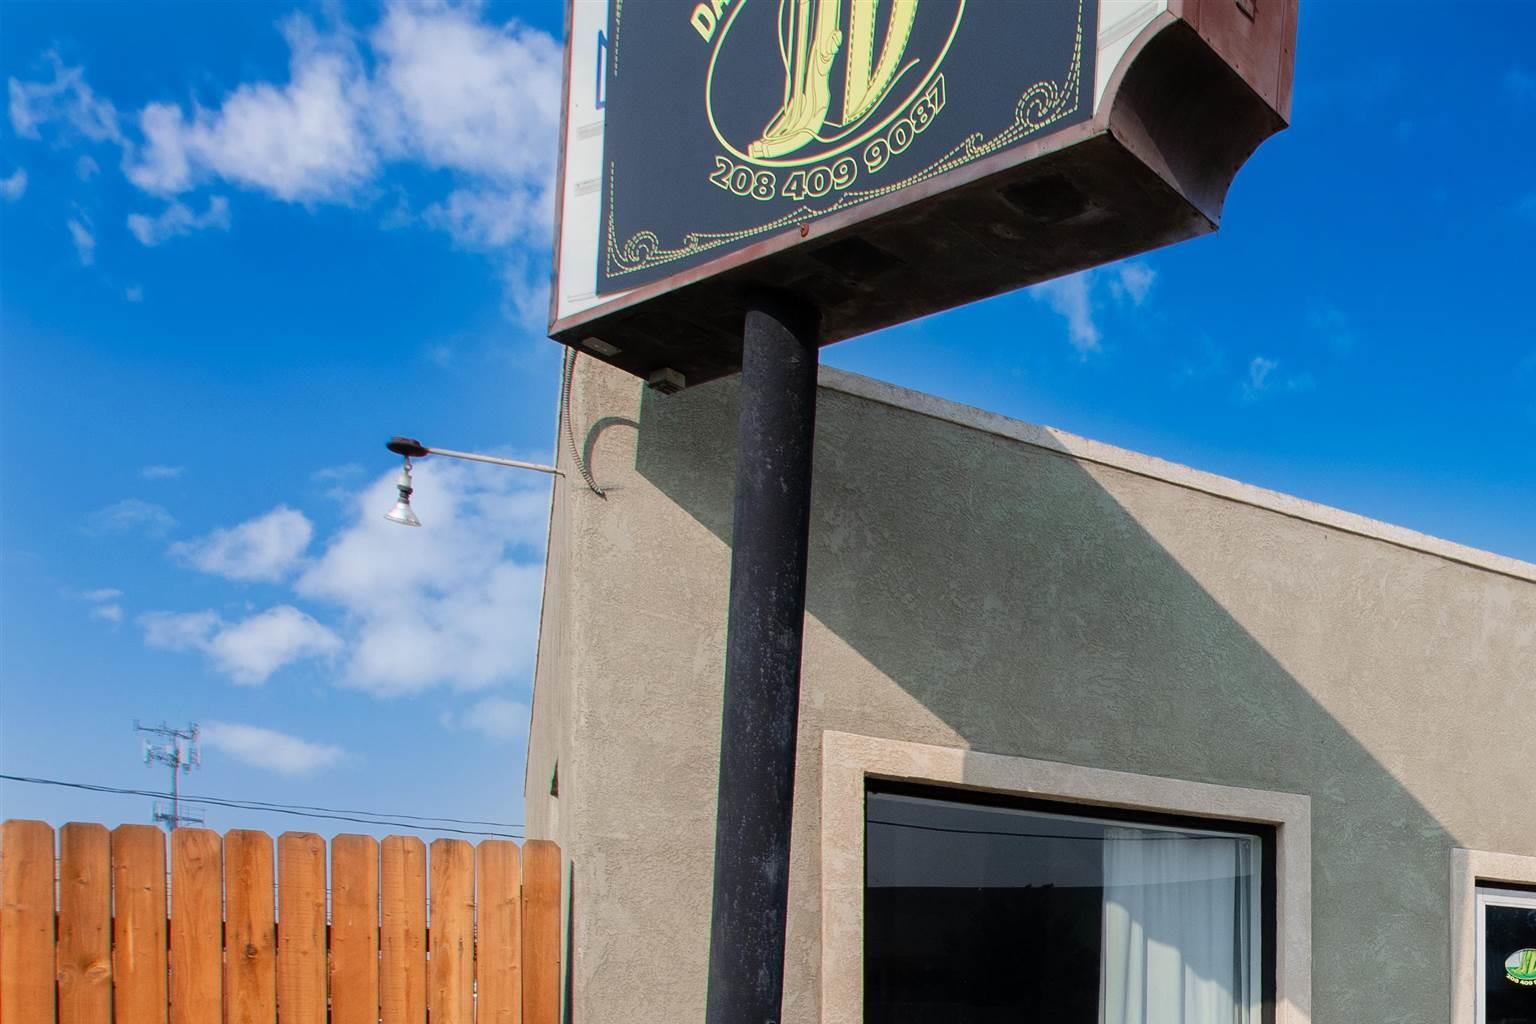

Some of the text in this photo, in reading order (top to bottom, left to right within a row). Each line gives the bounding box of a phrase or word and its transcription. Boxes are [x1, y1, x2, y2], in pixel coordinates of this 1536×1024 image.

[709, 72, 946, 200] 208 409 9087
